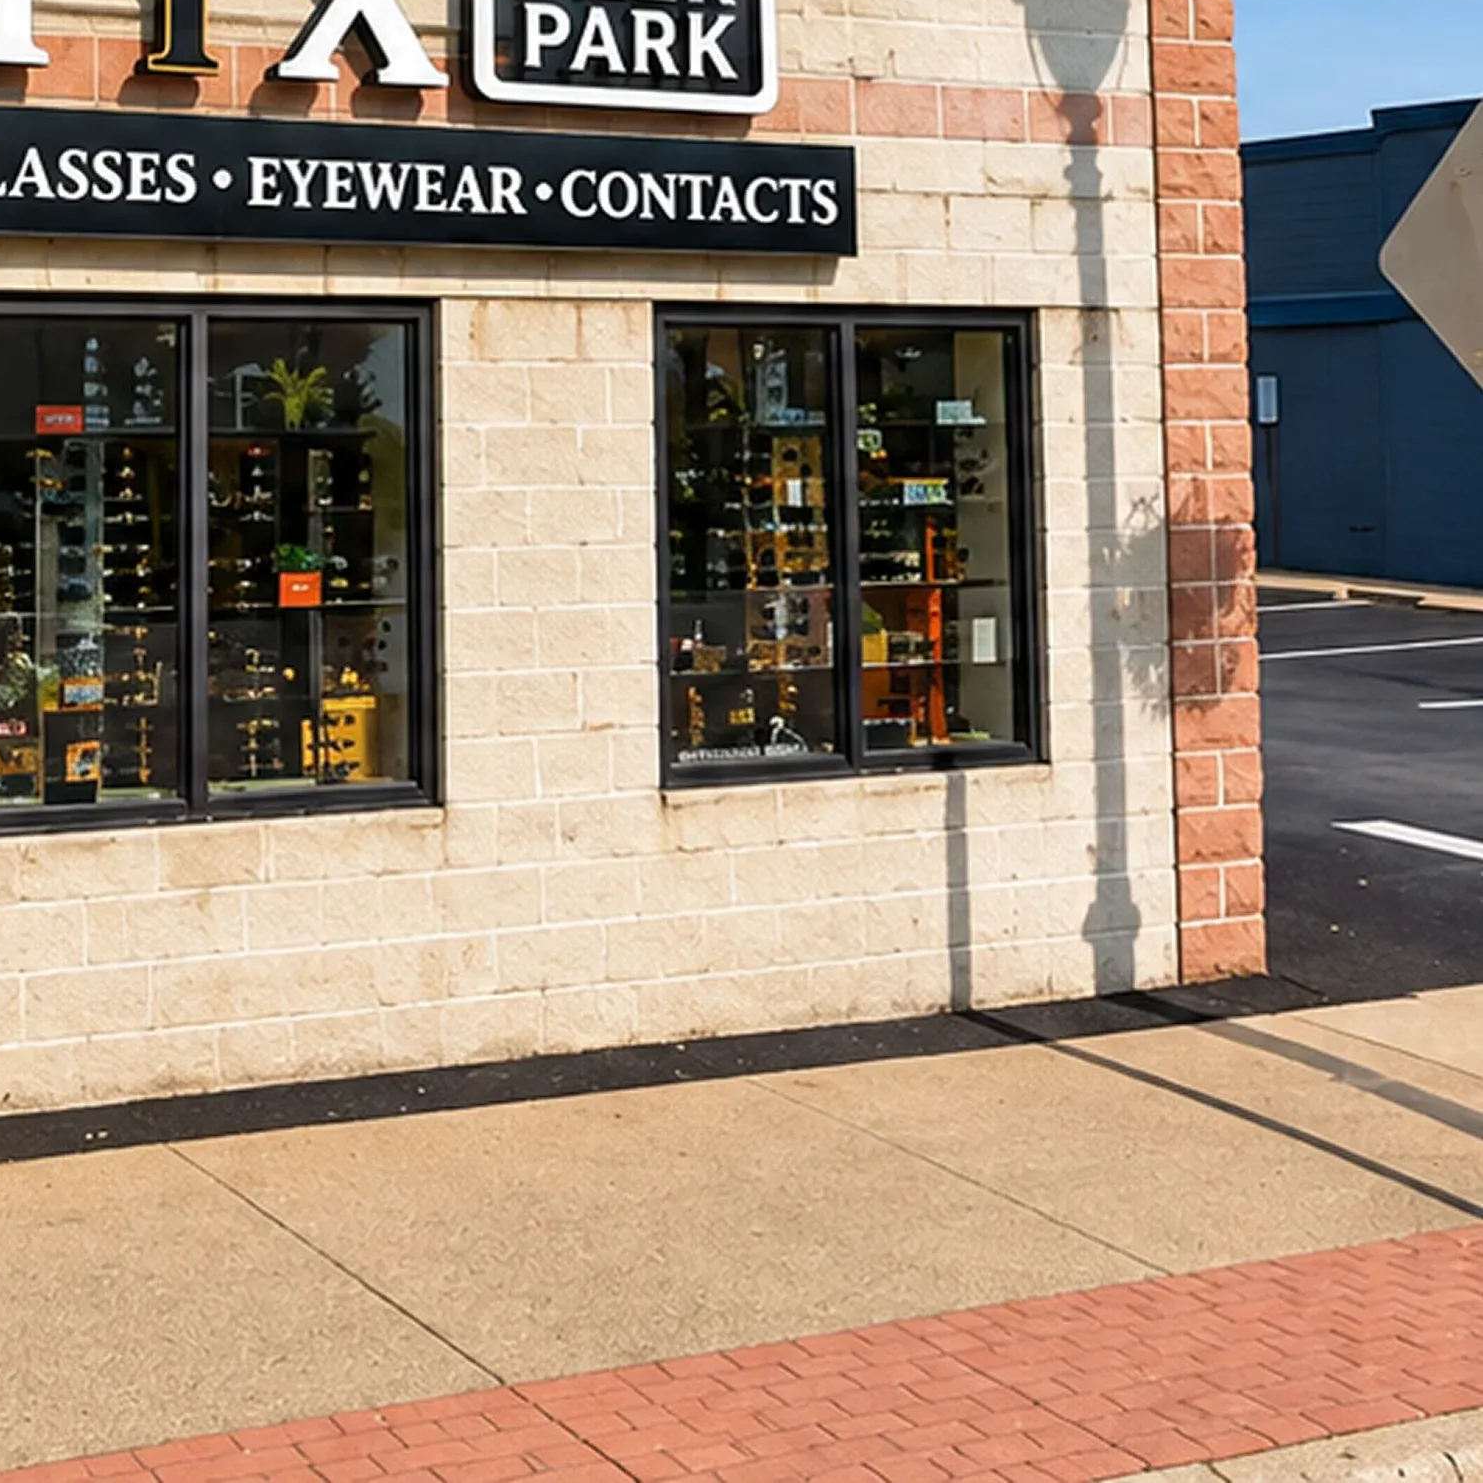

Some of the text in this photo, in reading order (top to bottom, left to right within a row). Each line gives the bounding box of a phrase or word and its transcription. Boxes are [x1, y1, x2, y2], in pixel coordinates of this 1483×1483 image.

[523, 2, 738, 79] PARK
[247, 156, 527, 214] EYEWEAR
[561, 169, 838, 225] CONTACTS
